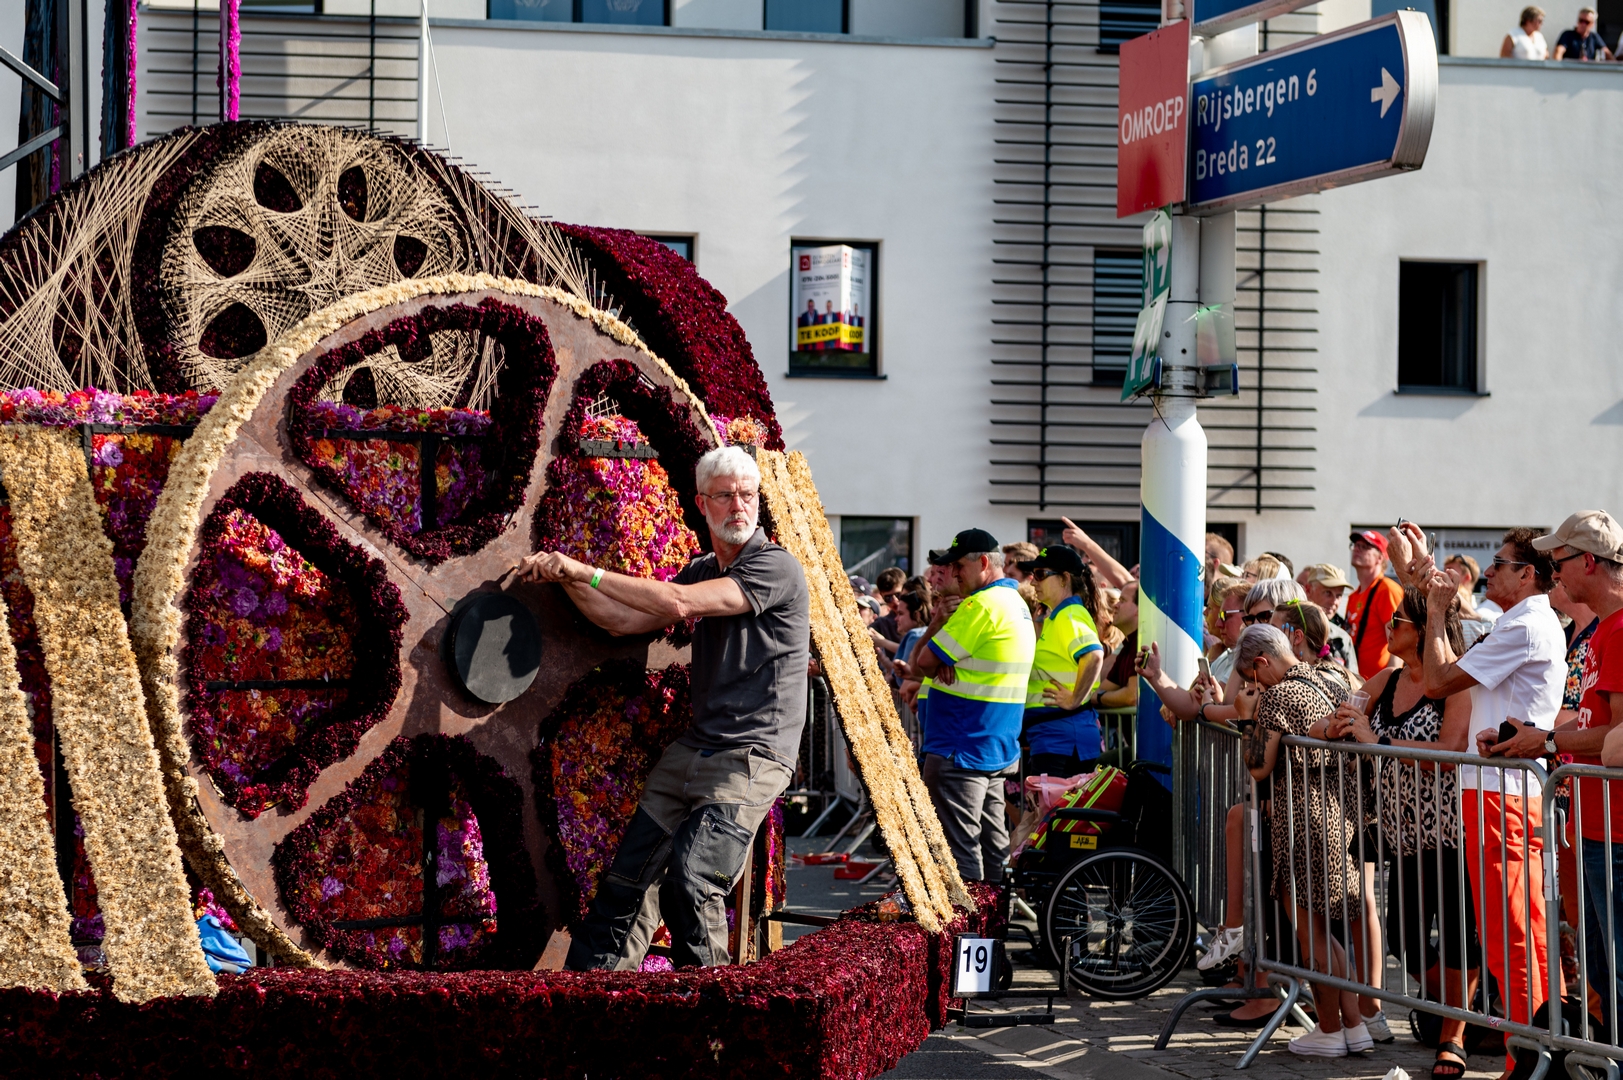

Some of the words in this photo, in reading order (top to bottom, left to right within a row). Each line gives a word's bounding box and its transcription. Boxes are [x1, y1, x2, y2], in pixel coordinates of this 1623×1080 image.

[1197, 74, 1299, 132] Rijsbergen
[1306, 68, 1317, 96] 6
[1121, 96, 1184, 145] OMROEP
[1196, 140, 1249, 180] Breda
[1255, 136, 1277, 166] 22
[800, 330, 812, 340] TE
[815, 326, 840, 338] KOOP
[1443, 540, 1490, 550] GEMAAKT
[963, 945, 988, 973] 19
